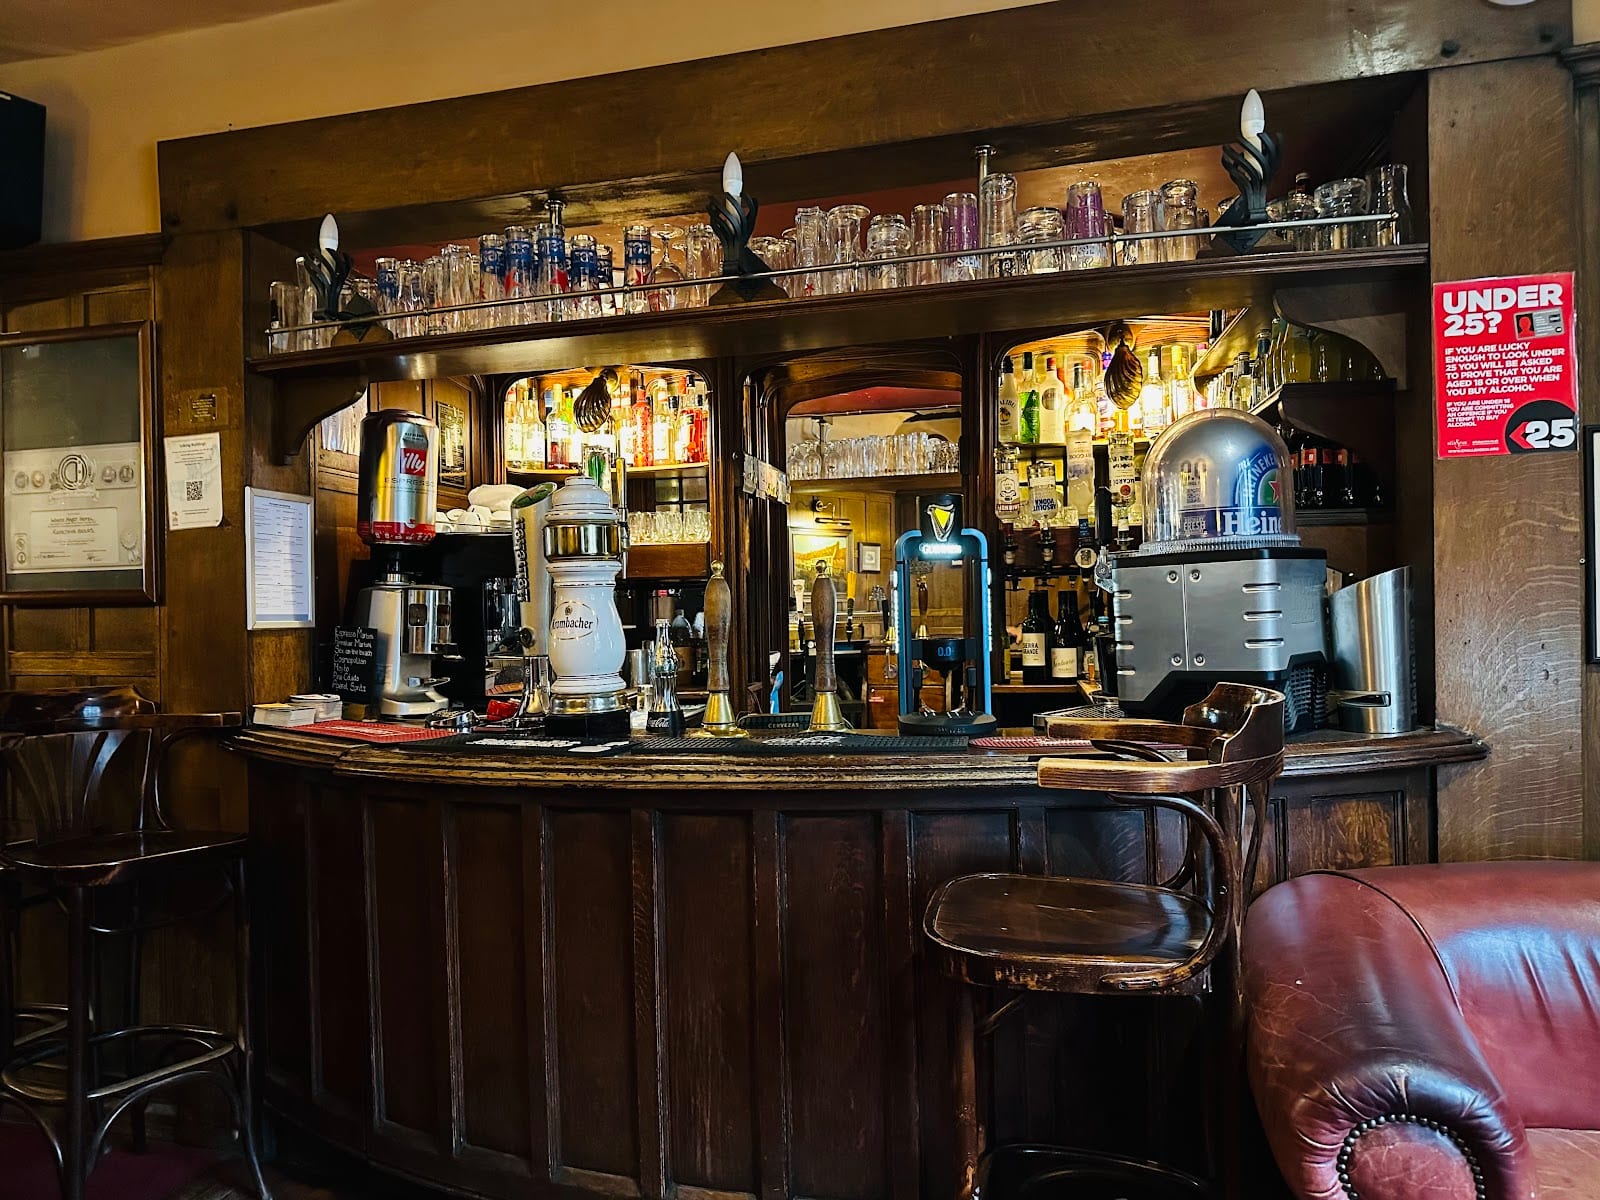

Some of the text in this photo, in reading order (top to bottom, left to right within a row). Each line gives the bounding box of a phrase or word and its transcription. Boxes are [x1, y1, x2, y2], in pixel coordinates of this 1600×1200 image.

[1443, 284, 1563, 314] UNDER
[1444, 312, 1502, 337] 25?
[1446, 348, 1564, 363] ENOUGH TO LOOK UNDER
[1456, 346, 1476, 355] YOU
[1499, 342, 1530, 351] LUCKY
[1459, 362, 1478, 371] YOU
[1520, 358, 1552, 366] ASKED
[1461, 370, 1492, 379] PROVE
[1494, 368, 1518, 376] THAT
[1520, 367, 1540, 375] YOU
[1446, 380, 1472, 388] AGED
[1501, 376, 1527, 384] OVER
[1529, 374, 1560, 382] WHEN
[1447, 384, 1534, 396] YOU BUY ALCOHOL
[404, 452, 425, 473] illy
[514, 518, 530, 602] Heineken
